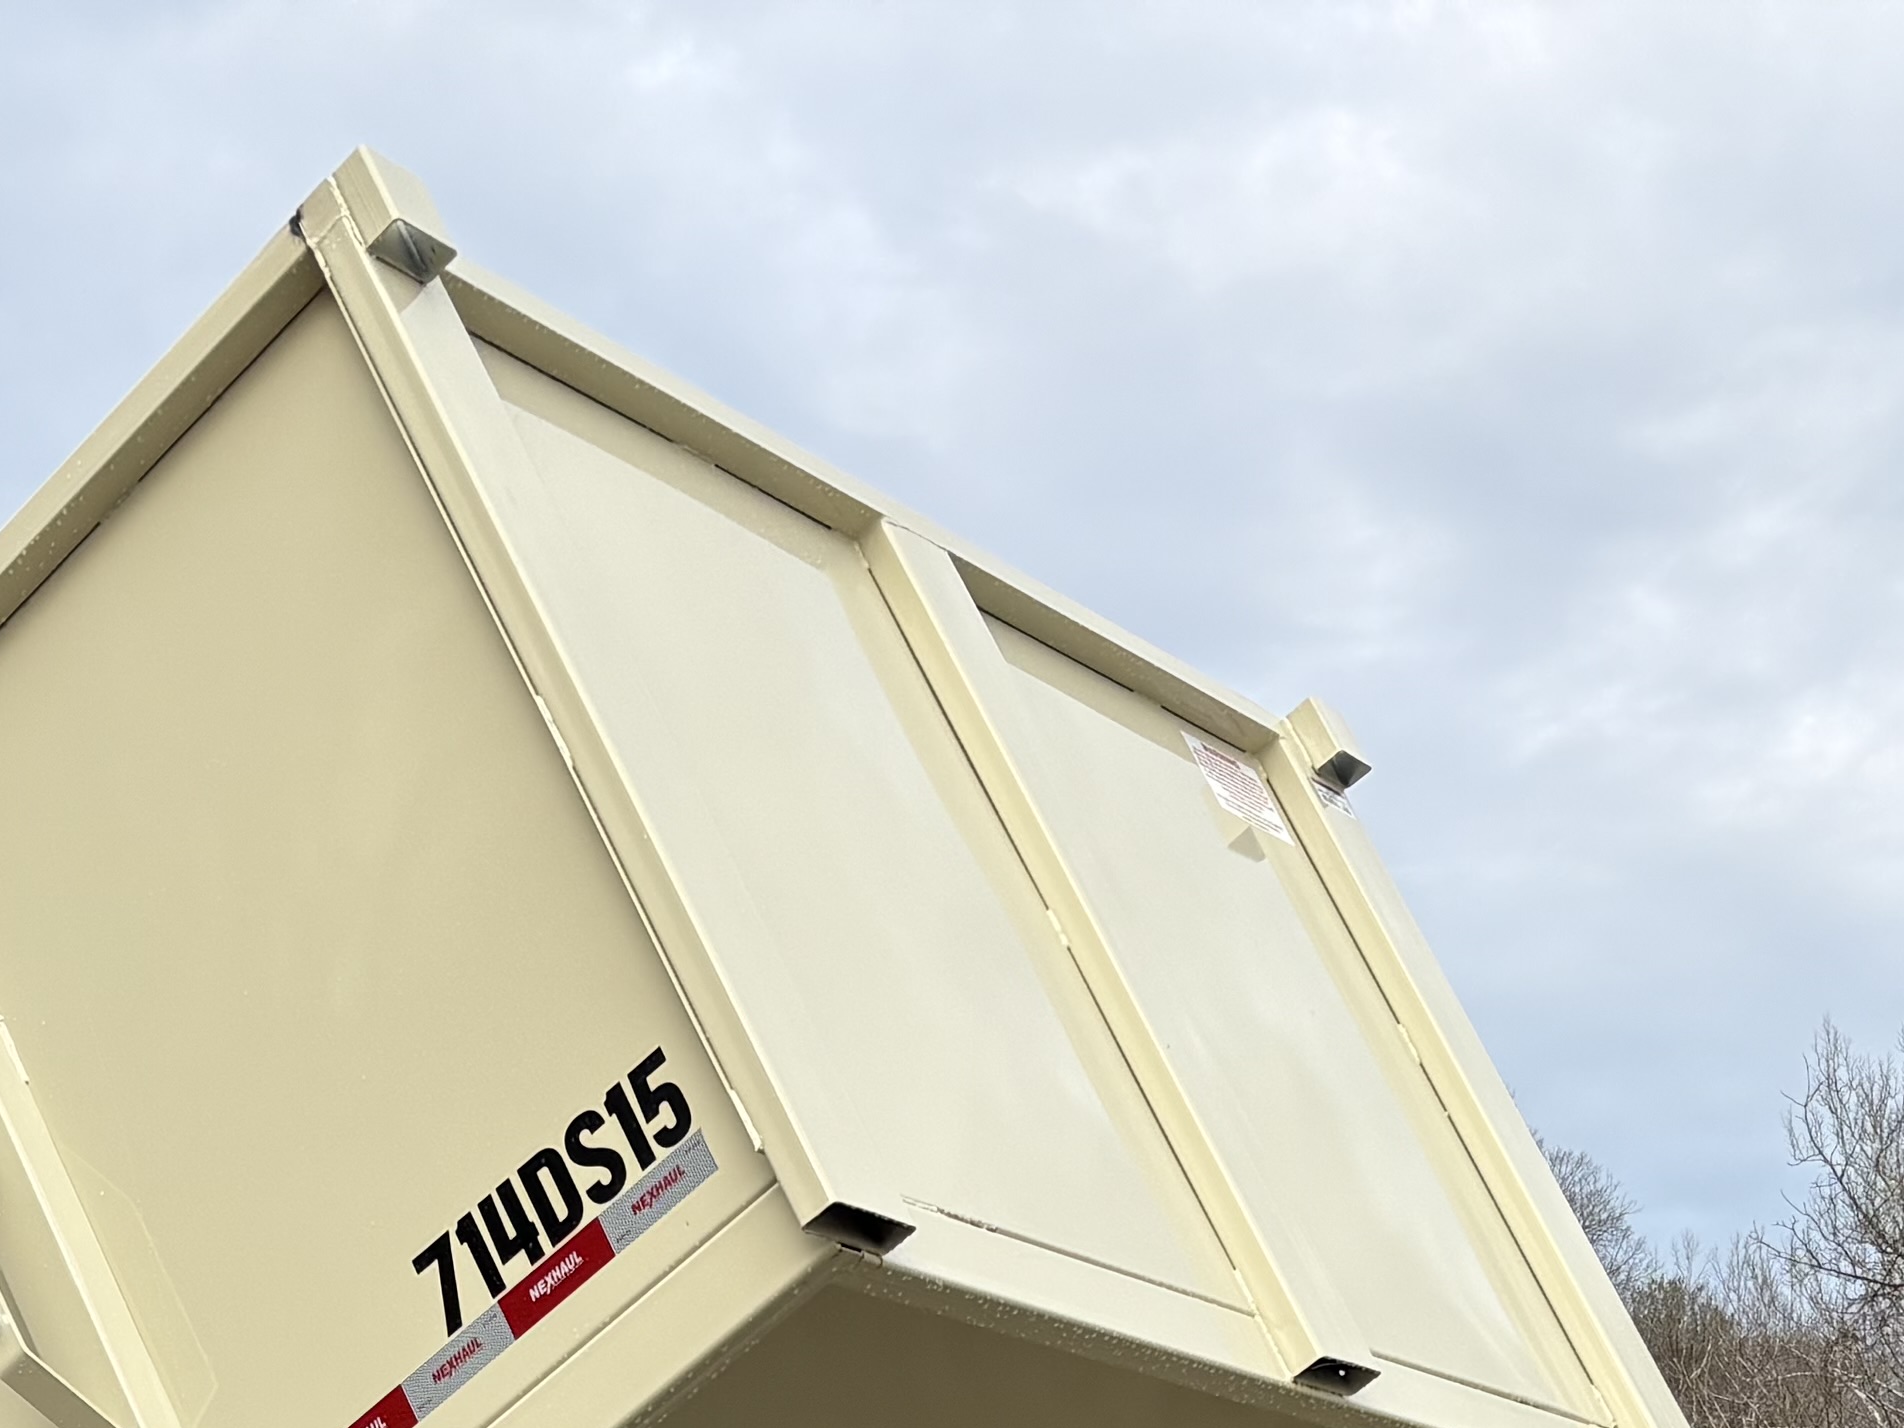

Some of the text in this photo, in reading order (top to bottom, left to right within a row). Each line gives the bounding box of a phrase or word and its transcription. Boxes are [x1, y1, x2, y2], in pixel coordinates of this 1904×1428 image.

[412, 1045, 694, 1338] 714DS15
[631, 1164, 686, 1216] NEXHAUL
[528, 1250, 584, 1302] NEXHAUL
[431, 1337, 484, 1385] NEXHAUL
